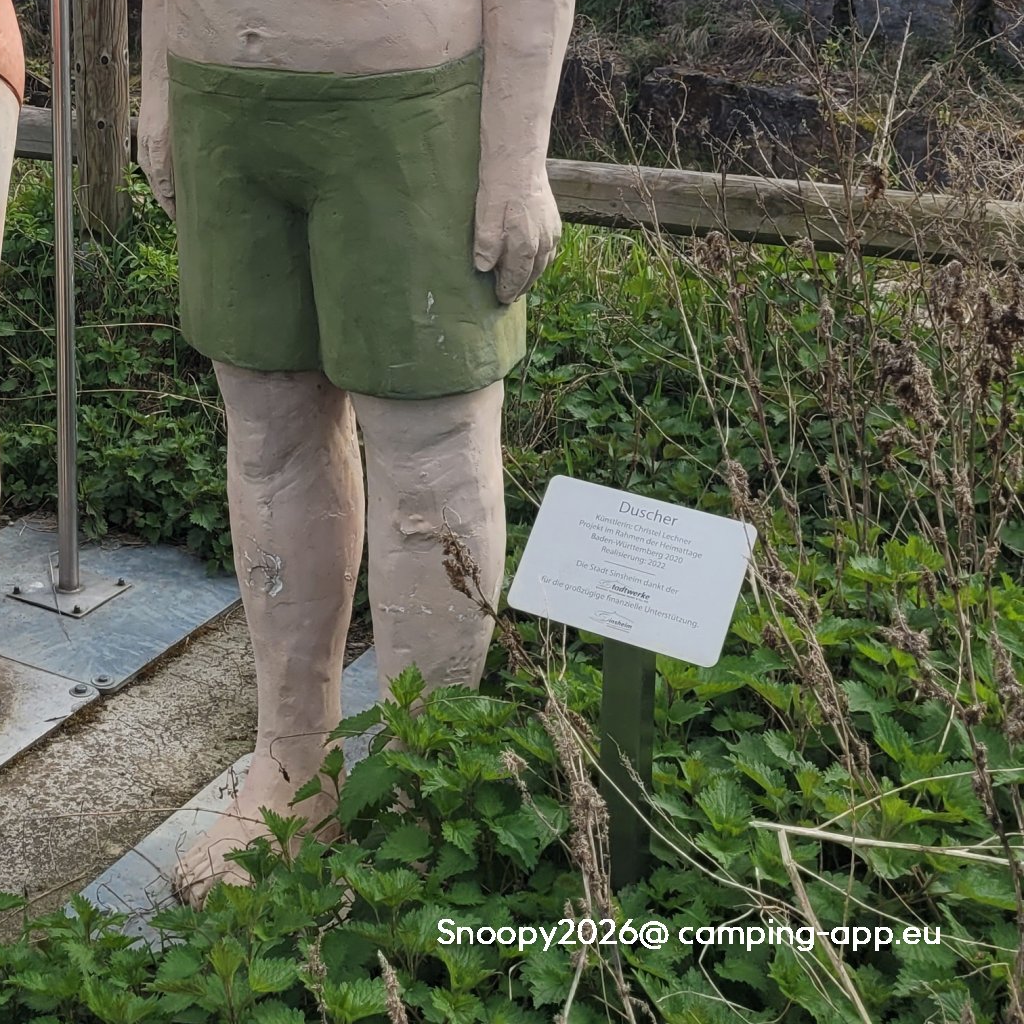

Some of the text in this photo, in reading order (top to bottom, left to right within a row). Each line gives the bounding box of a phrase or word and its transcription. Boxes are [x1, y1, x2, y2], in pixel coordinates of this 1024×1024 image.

[595, 514, 692, 545] Künstlerin: Christel Lechner
[619, 501, 679, 527] Duscher
[579, 519, 703, 559] Projekt im Rahmen der Heimattage
[591, 532, 684, 564] Baden-Württemberg 2020
[601, 545, 666, 569] Realisierung: 2022
[541, 575, 551, 584] für
[552, 579, 564, 587] die
[576, 559, 679, 595] Die Stadt Sinsheim dankt der
